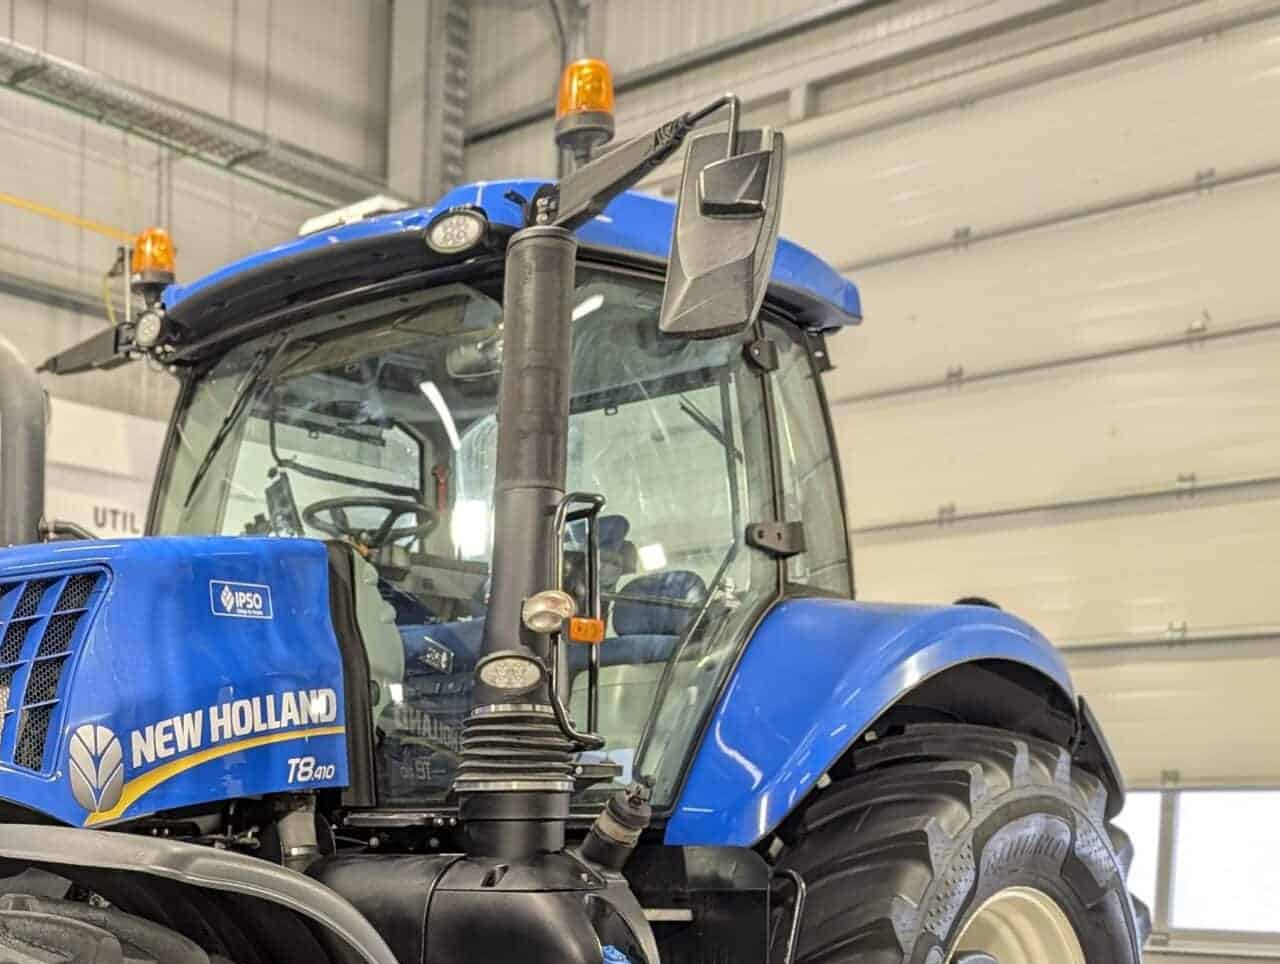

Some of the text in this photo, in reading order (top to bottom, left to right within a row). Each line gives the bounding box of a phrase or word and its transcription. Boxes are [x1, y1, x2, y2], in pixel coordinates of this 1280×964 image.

[93, 505, 140, 534] UTIL
[235, 591, 263, 609] IPSO
[131, 687, 338, 769] NEW HOLLAND
